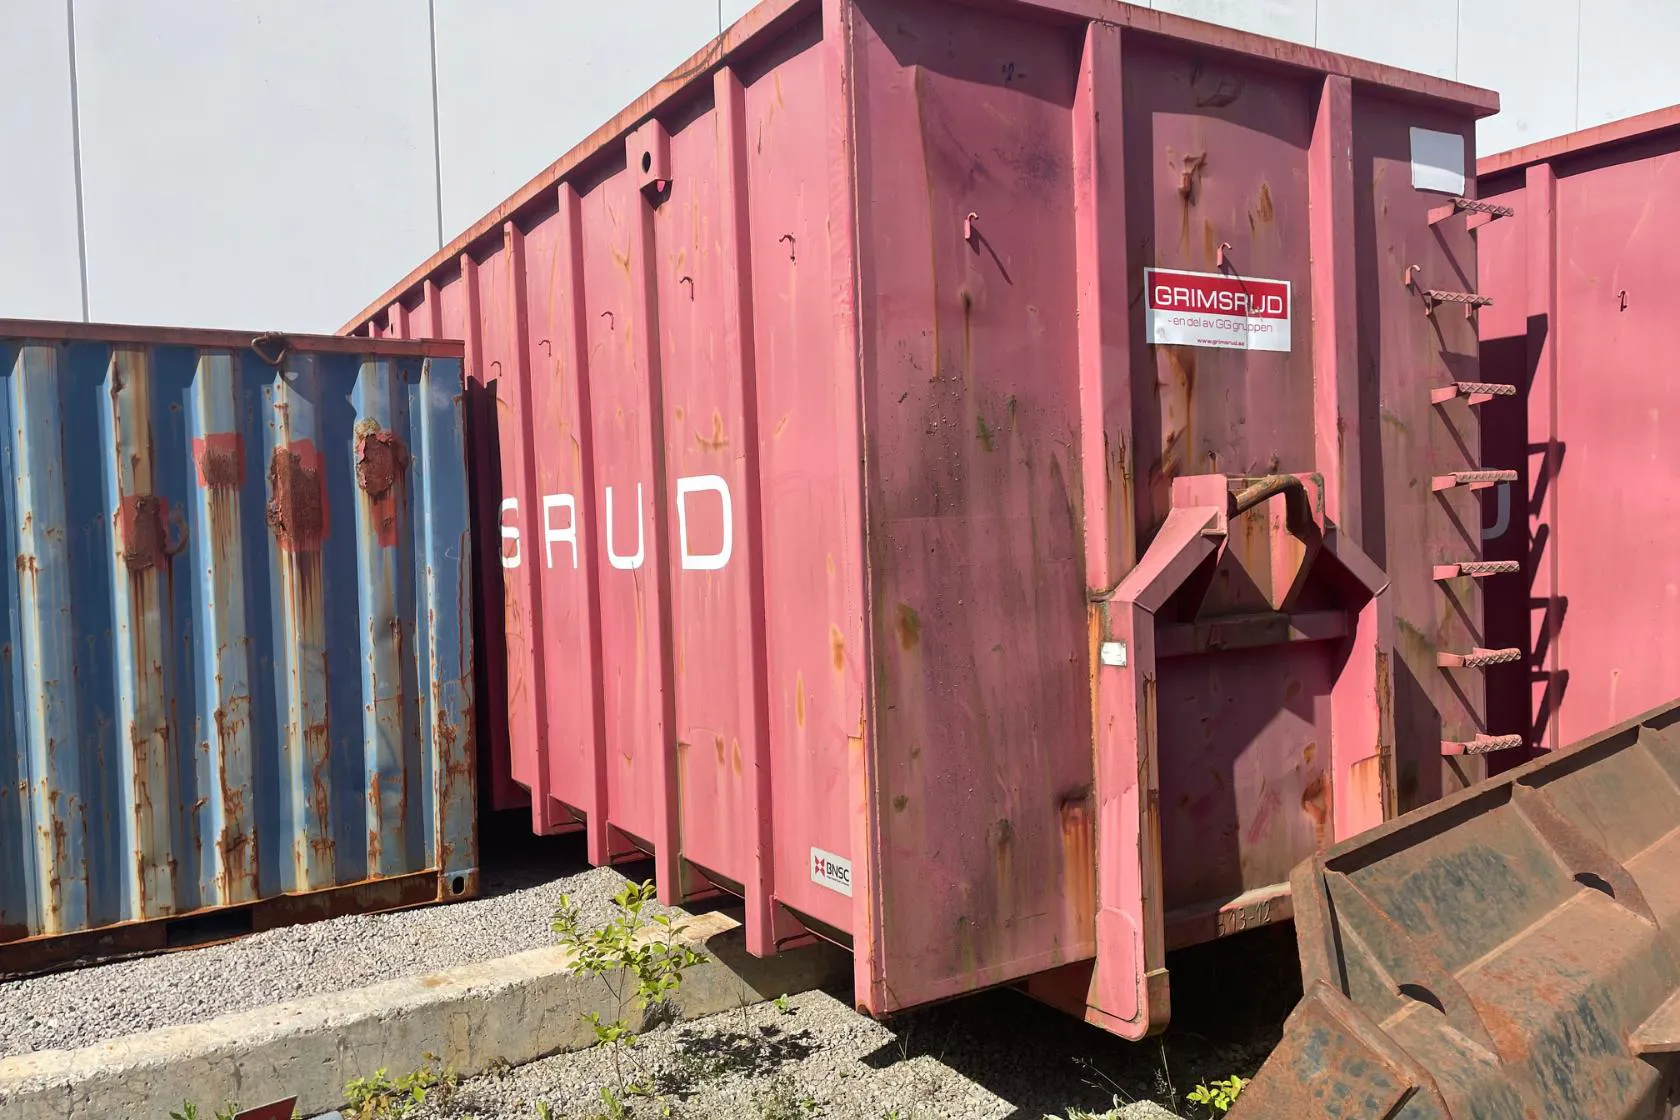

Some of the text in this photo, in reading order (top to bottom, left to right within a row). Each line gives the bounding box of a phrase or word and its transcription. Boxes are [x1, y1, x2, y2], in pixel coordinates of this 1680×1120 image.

[1155, 285, 1283, 314] GRIMSRUD
[1187, 317, 1201, 327] del
[1203, 320, 1215, 329] av
[1232, 321, 1273, 333] gruppen
[826, 862, 850, 882] BNSC
